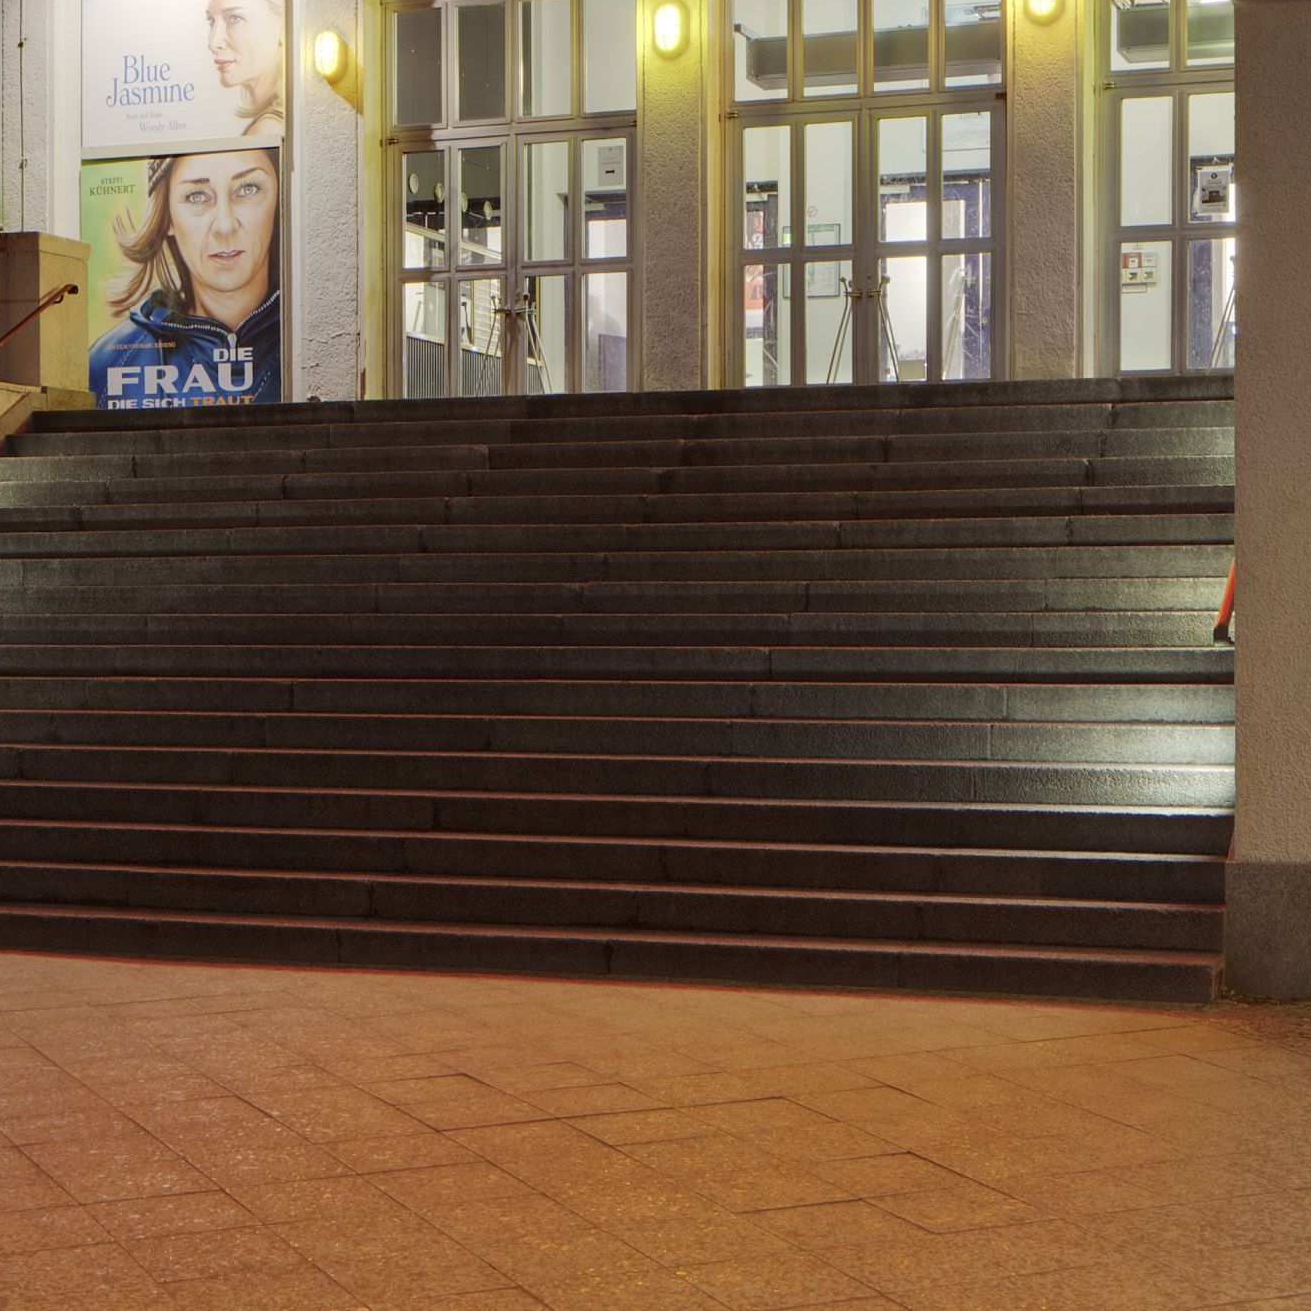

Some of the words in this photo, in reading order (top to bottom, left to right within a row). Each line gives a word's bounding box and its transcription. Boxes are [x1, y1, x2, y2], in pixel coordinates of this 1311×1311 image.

[122, 54, 171, 84] Blue
[106, 77, 195, 108] Jasmine
[90, 184, 136, 196] KÜHNERT
[213, 347, 253, 362] DIE
[107, 362, 253, 396] FRAU
[108, 399, 137, 409] DIE
[142, 398, 185, 409] SICH
[190, 395, 253, 407] TRAUT
